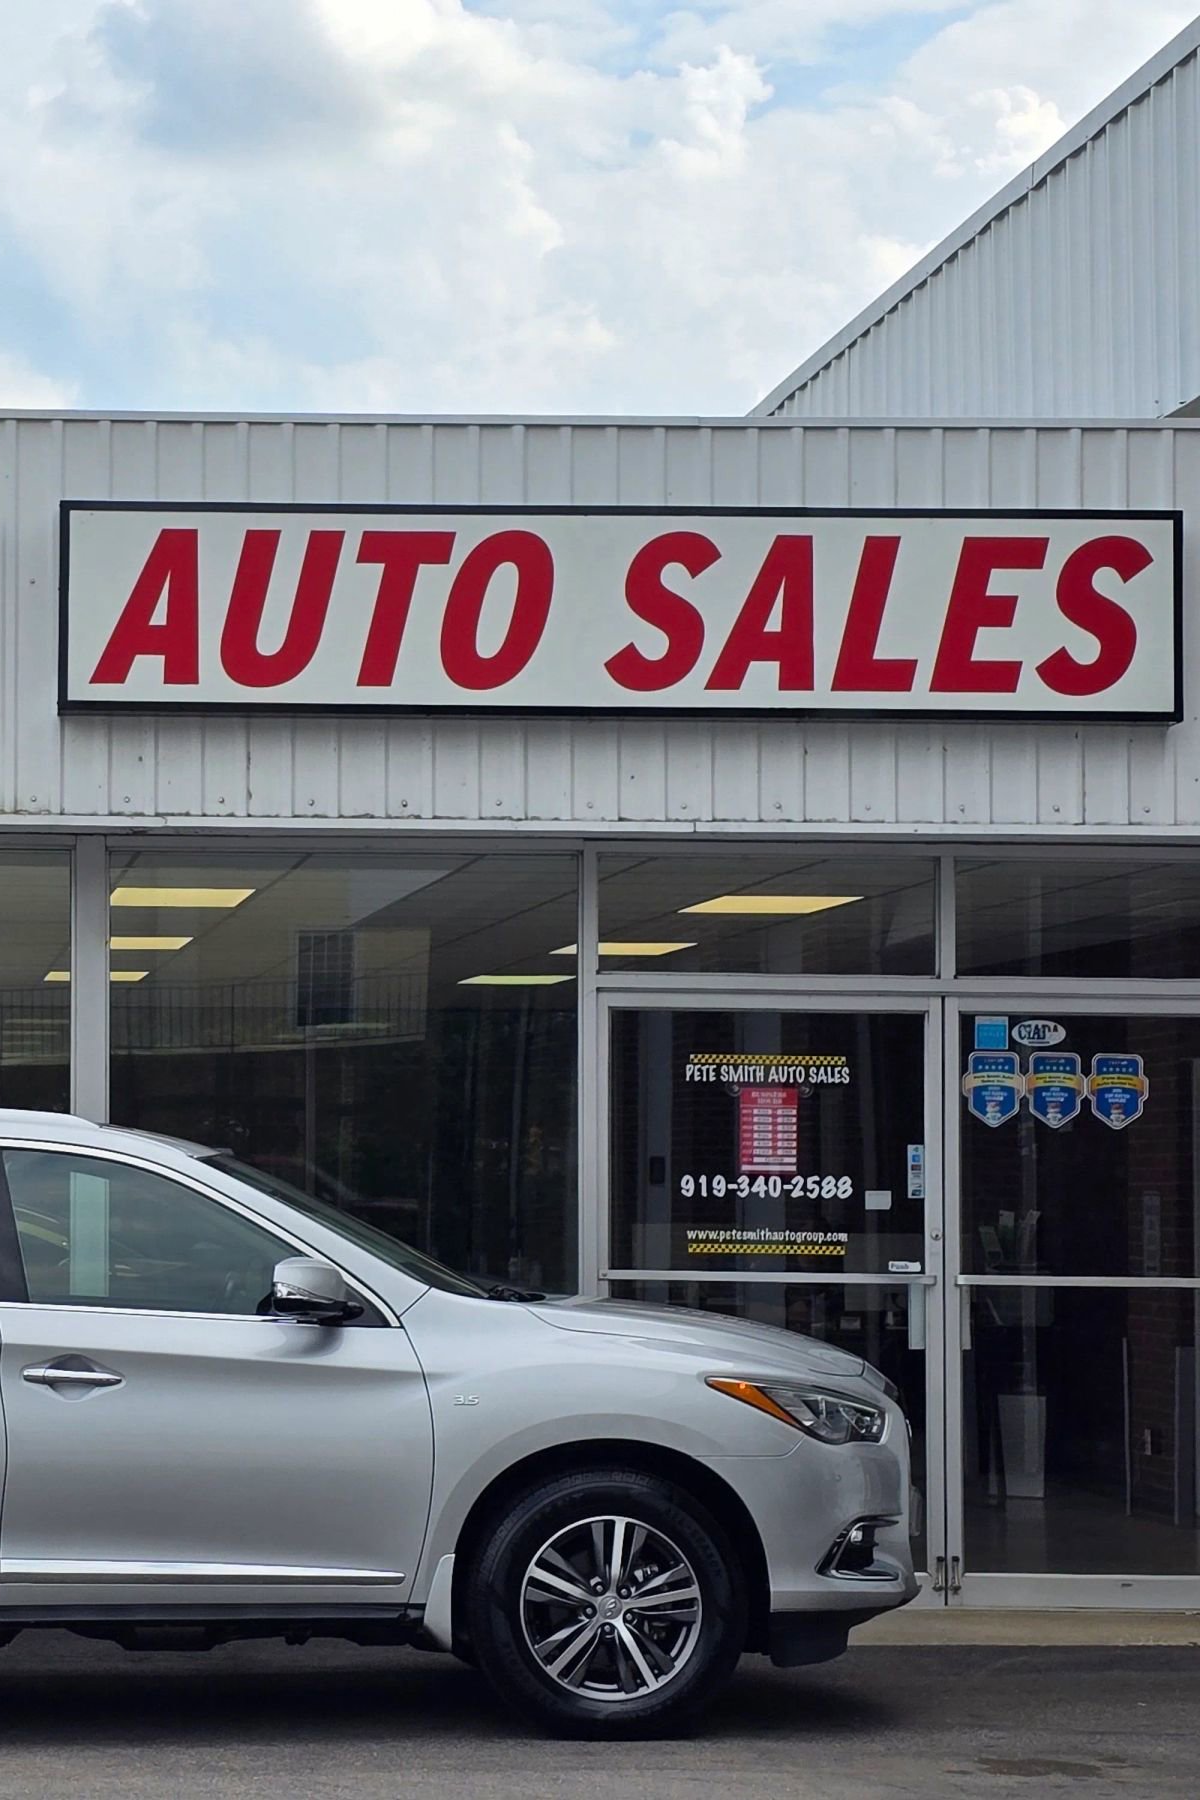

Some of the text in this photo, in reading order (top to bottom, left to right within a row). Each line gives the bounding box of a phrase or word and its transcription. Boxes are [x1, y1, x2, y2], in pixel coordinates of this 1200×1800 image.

[89, 528, 1154, 696] AUTO SALES
[685, 1064, 850, 1084] PETE SMITH AUTO SALES
[680, 1174, 853, 1199] 919-340-2588
[686, 1228, 848, 1244] www.petesmithautogroup.com
